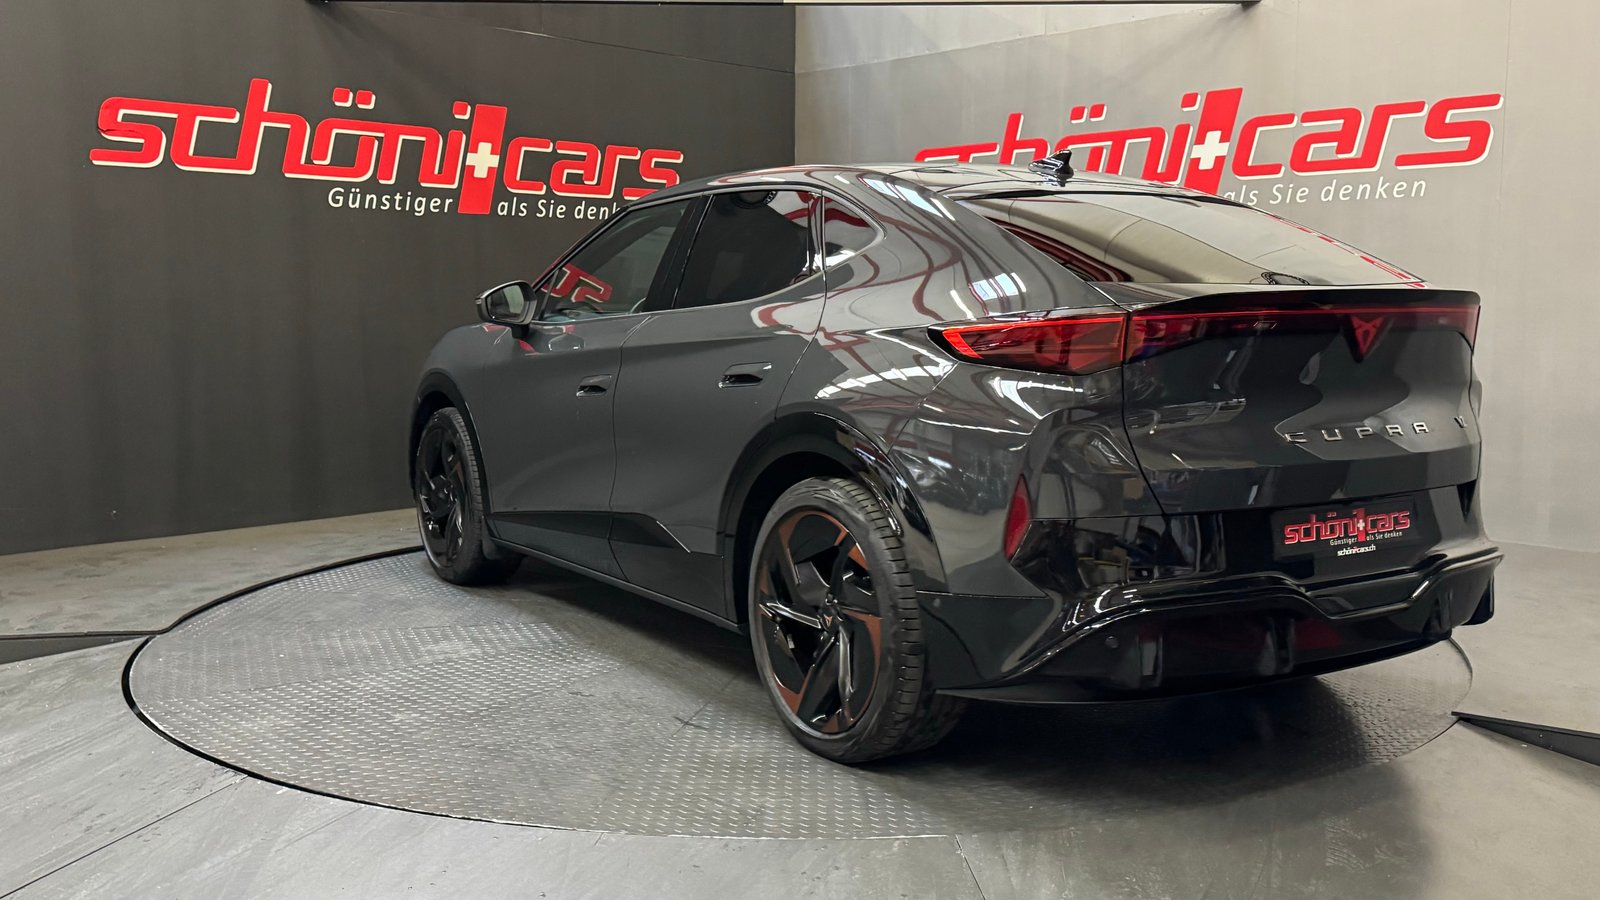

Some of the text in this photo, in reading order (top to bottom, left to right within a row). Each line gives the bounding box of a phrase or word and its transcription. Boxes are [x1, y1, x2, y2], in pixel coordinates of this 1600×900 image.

[1231, 93, 1504, 179] cars
[327, 187, 454, 217] Günstiger
[497, 197, 528, 217] als
[536, 199, 567, 219] Sie
[1269, 183, 1310, 204] Sie
[1320, 176, 1427, 202] denken
[1285, 421, 1430, 443] CUPRA
